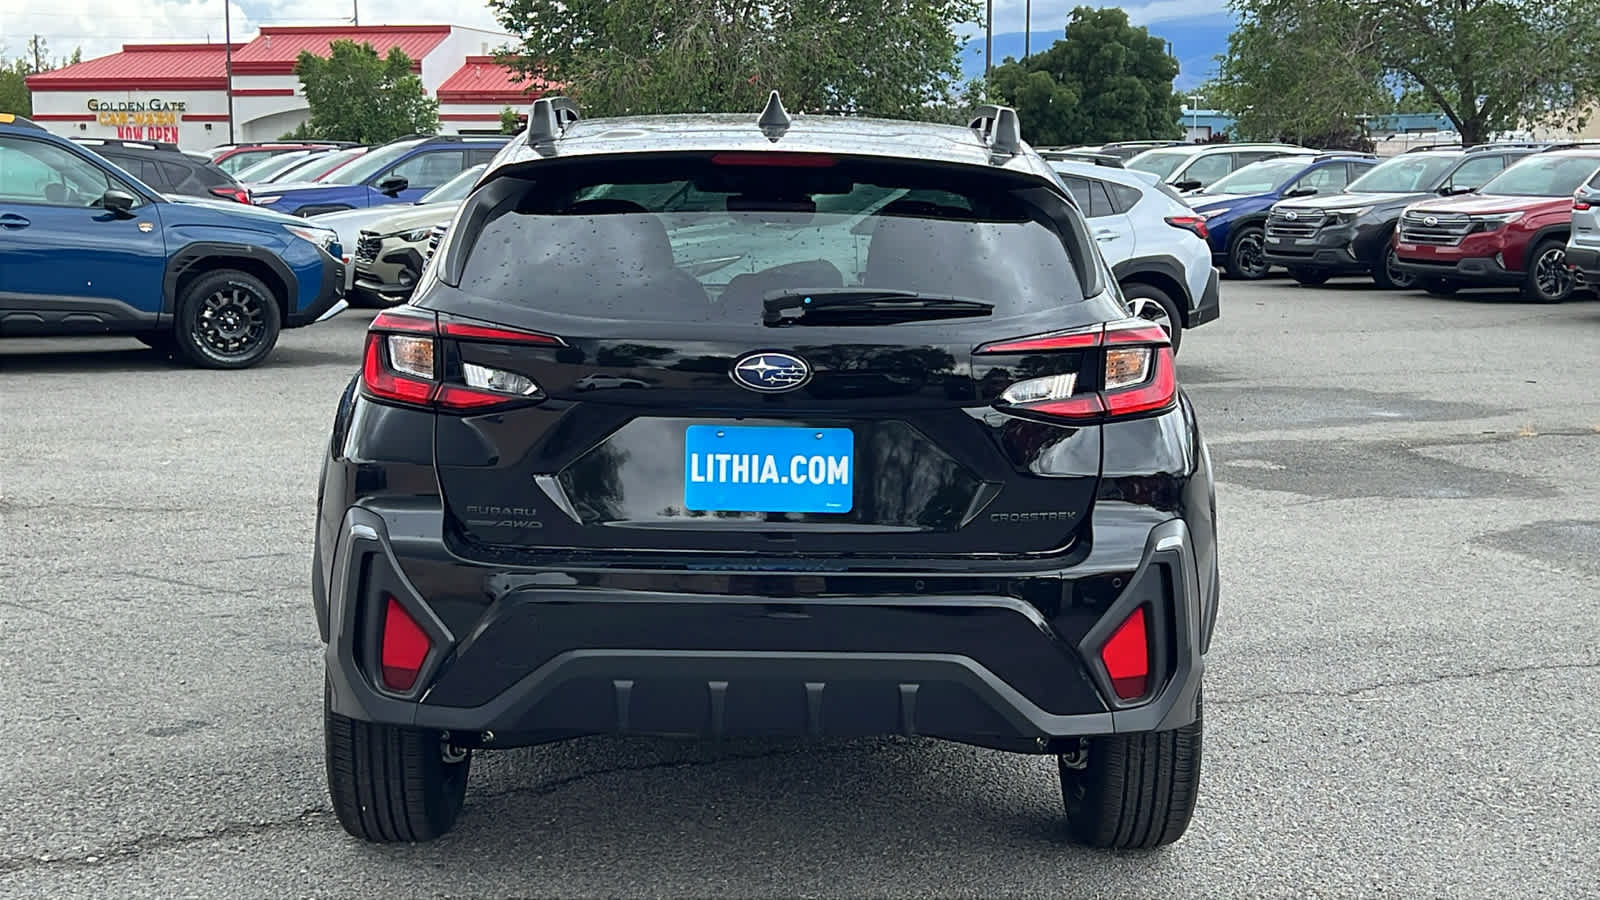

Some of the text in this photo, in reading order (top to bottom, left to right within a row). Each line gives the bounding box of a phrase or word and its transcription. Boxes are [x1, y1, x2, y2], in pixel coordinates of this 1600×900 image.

[88, 98, 186, 112] GOLDEN GATE
[116, 125, 179, 143] NOW OPEN
[690, 453, 849, 485] LITHIA.COM
[466, 505, 537, 516] SUBARU
[990, 511, 1077, 522] CROSSTREK
[496, 520, 543, 529] AWD
